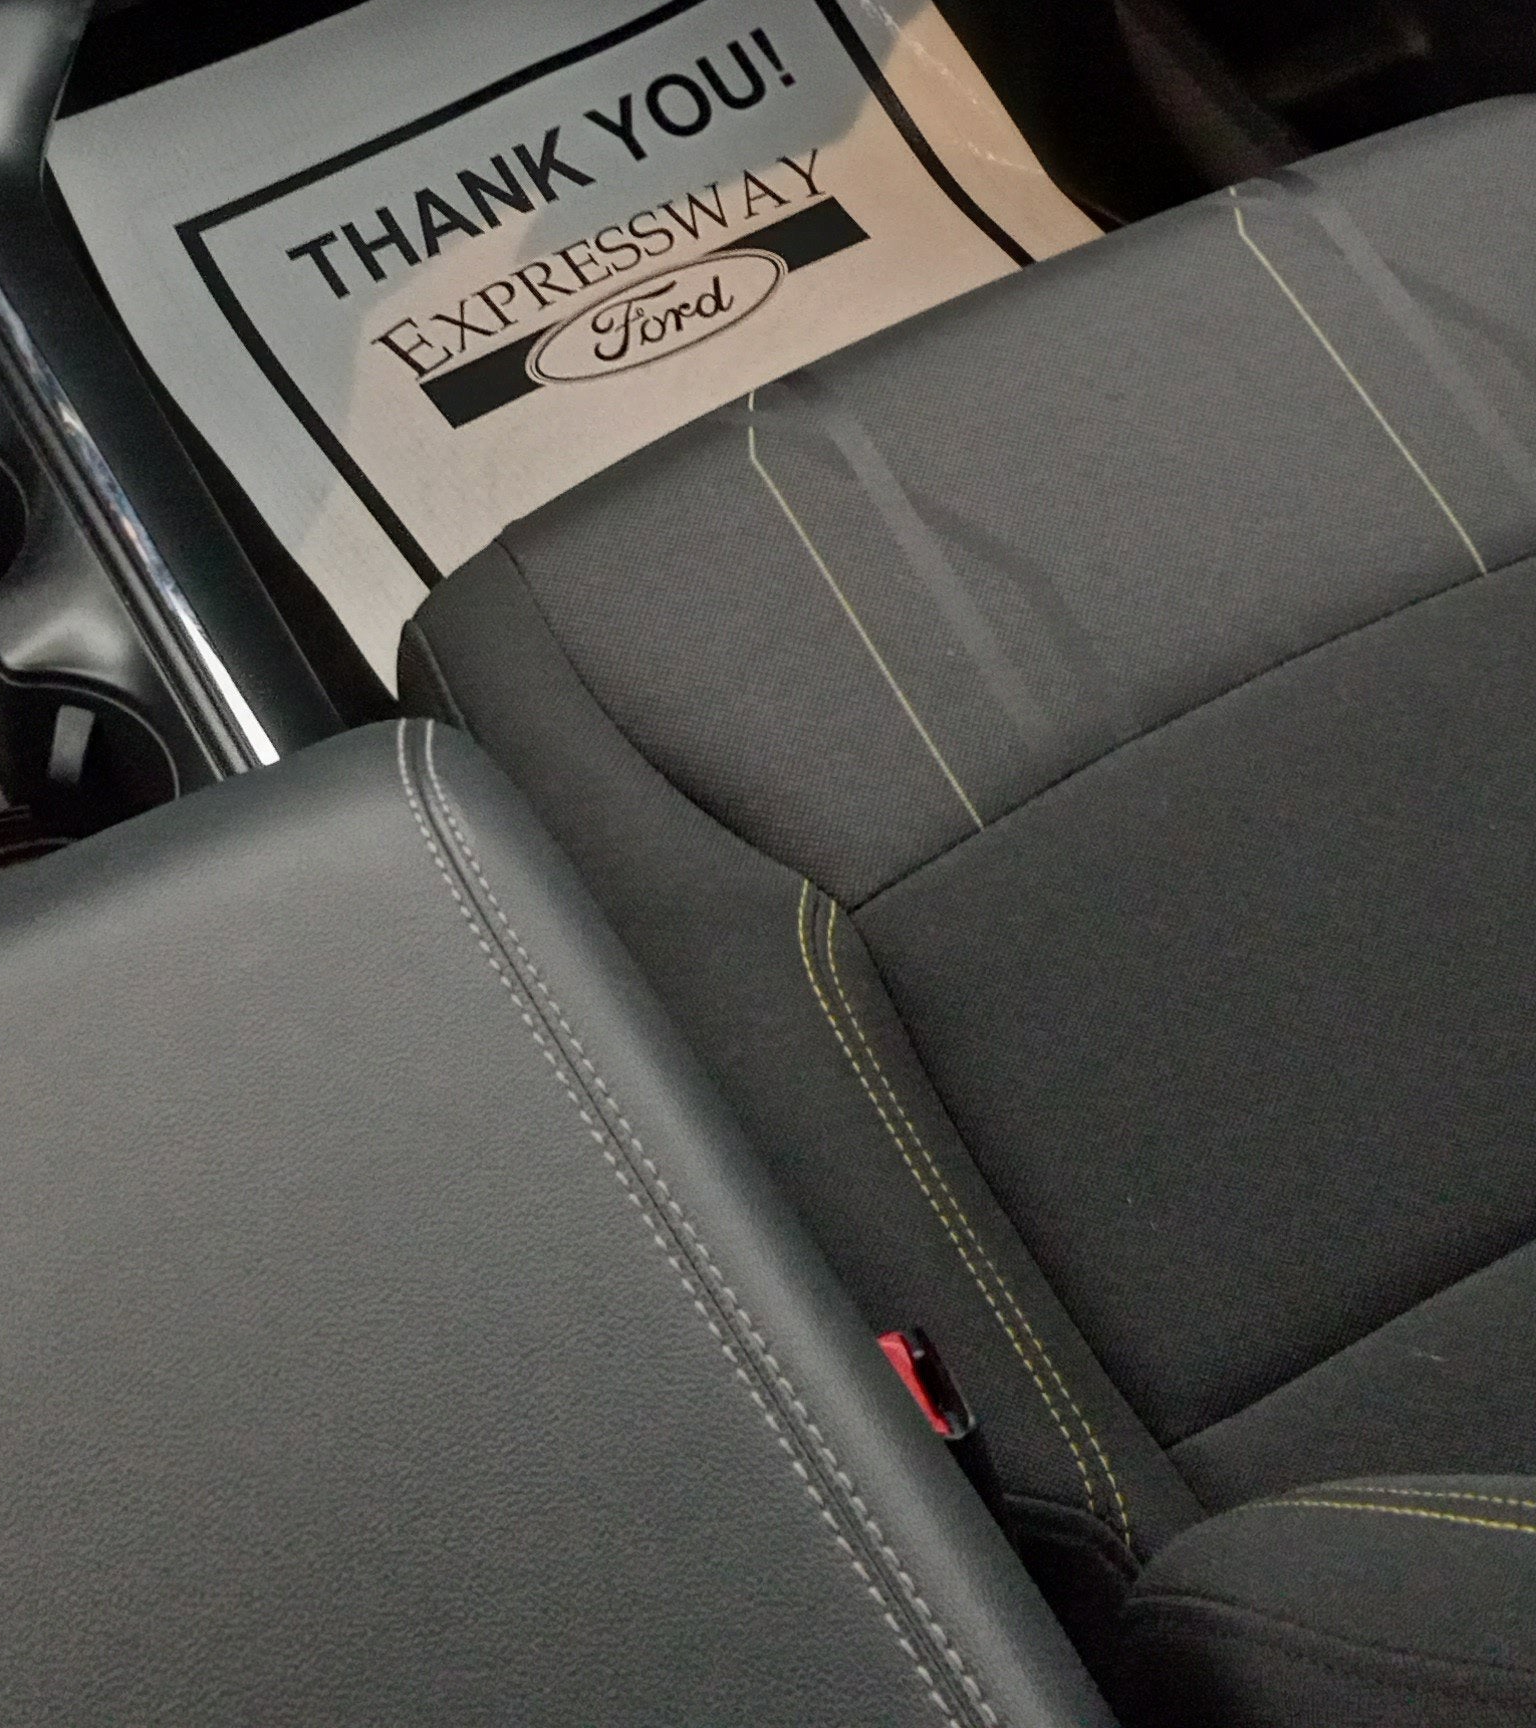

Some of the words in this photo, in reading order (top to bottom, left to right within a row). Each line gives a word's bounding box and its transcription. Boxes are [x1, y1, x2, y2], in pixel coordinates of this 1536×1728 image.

[286, 127, 595, 299] THANK
[582, 27, 797, 162] YOU!
[372, 149, 830, 382] EXPRESSWAY
[594, 274, 735, 364] Ford
